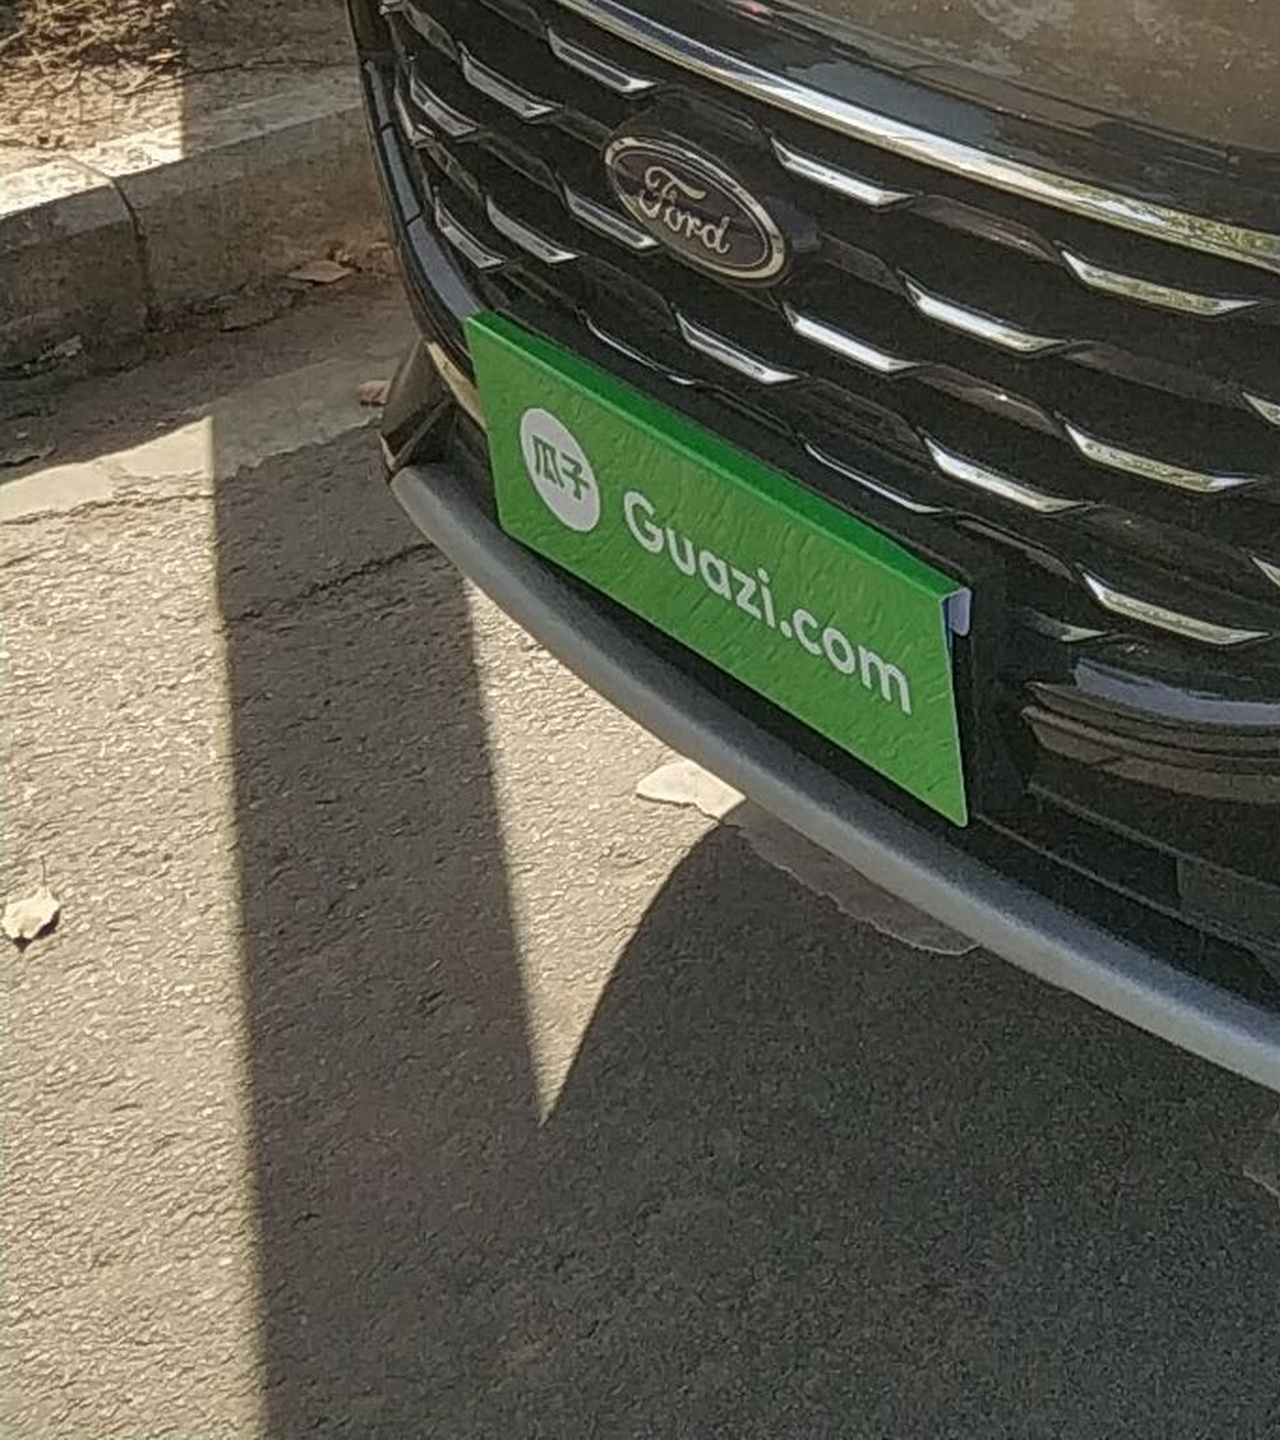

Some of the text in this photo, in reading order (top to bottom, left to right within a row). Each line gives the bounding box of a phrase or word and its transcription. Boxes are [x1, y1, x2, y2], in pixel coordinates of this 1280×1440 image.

[638, 165, 731, 254] Ford
[531, 435, 592, 501] 瓜子
[623, 491, 913, 716] Guazi.com
